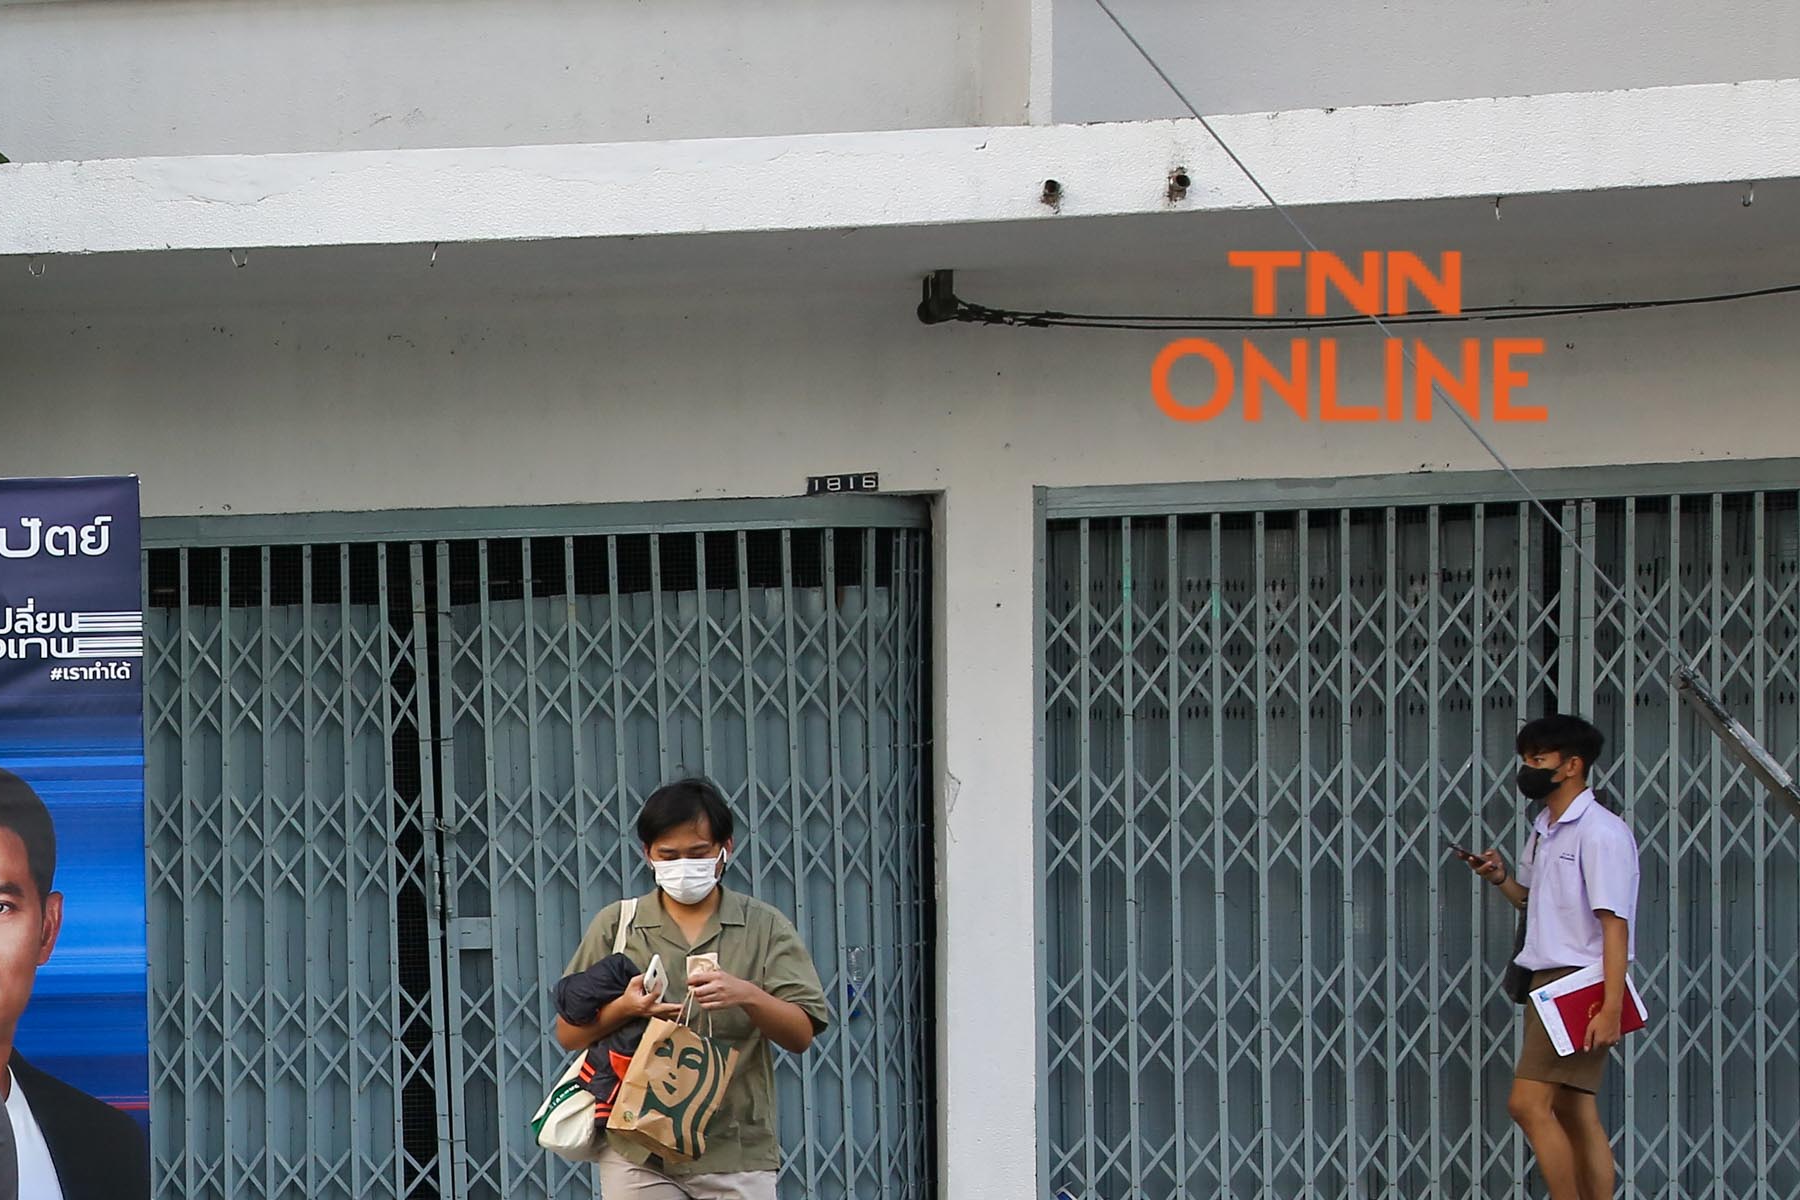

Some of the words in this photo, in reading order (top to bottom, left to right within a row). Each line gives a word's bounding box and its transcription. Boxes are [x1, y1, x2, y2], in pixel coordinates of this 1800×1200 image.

[815, 475, 876, 491] 1816
[50, 661, 132, 681] #เราทำได้
